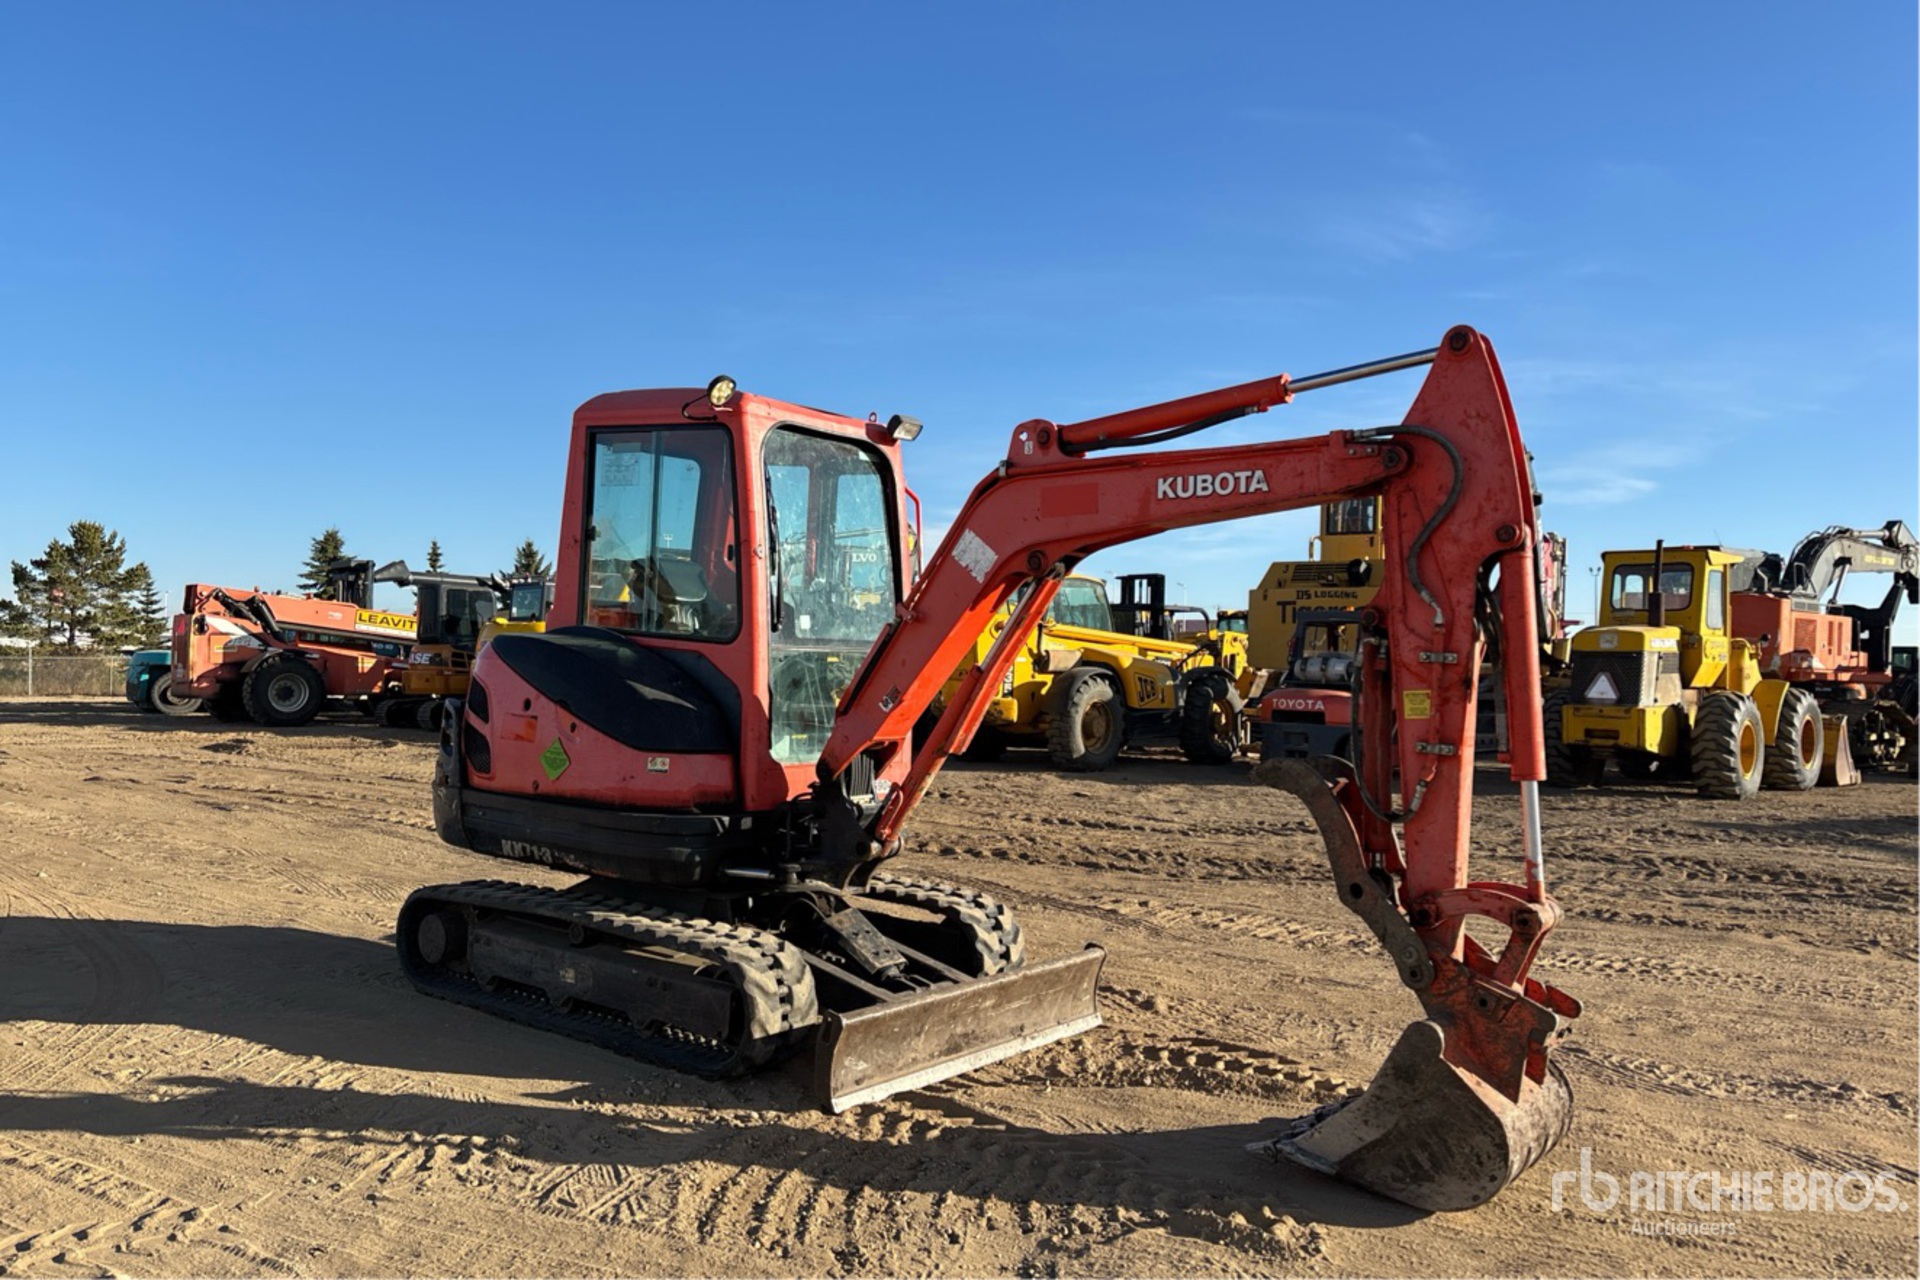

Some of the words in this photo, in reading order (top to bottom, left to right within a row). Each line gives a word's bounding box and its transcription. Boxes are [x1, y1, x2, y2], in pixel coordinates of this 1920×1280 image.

[1157, 469, 1269, 499] KUBOTA
[1314, 590, 1358, 599] LOGGING
[1137, 675, 1156, 703] JCB
[1272, 698, 1325, 710] TOYOTA
